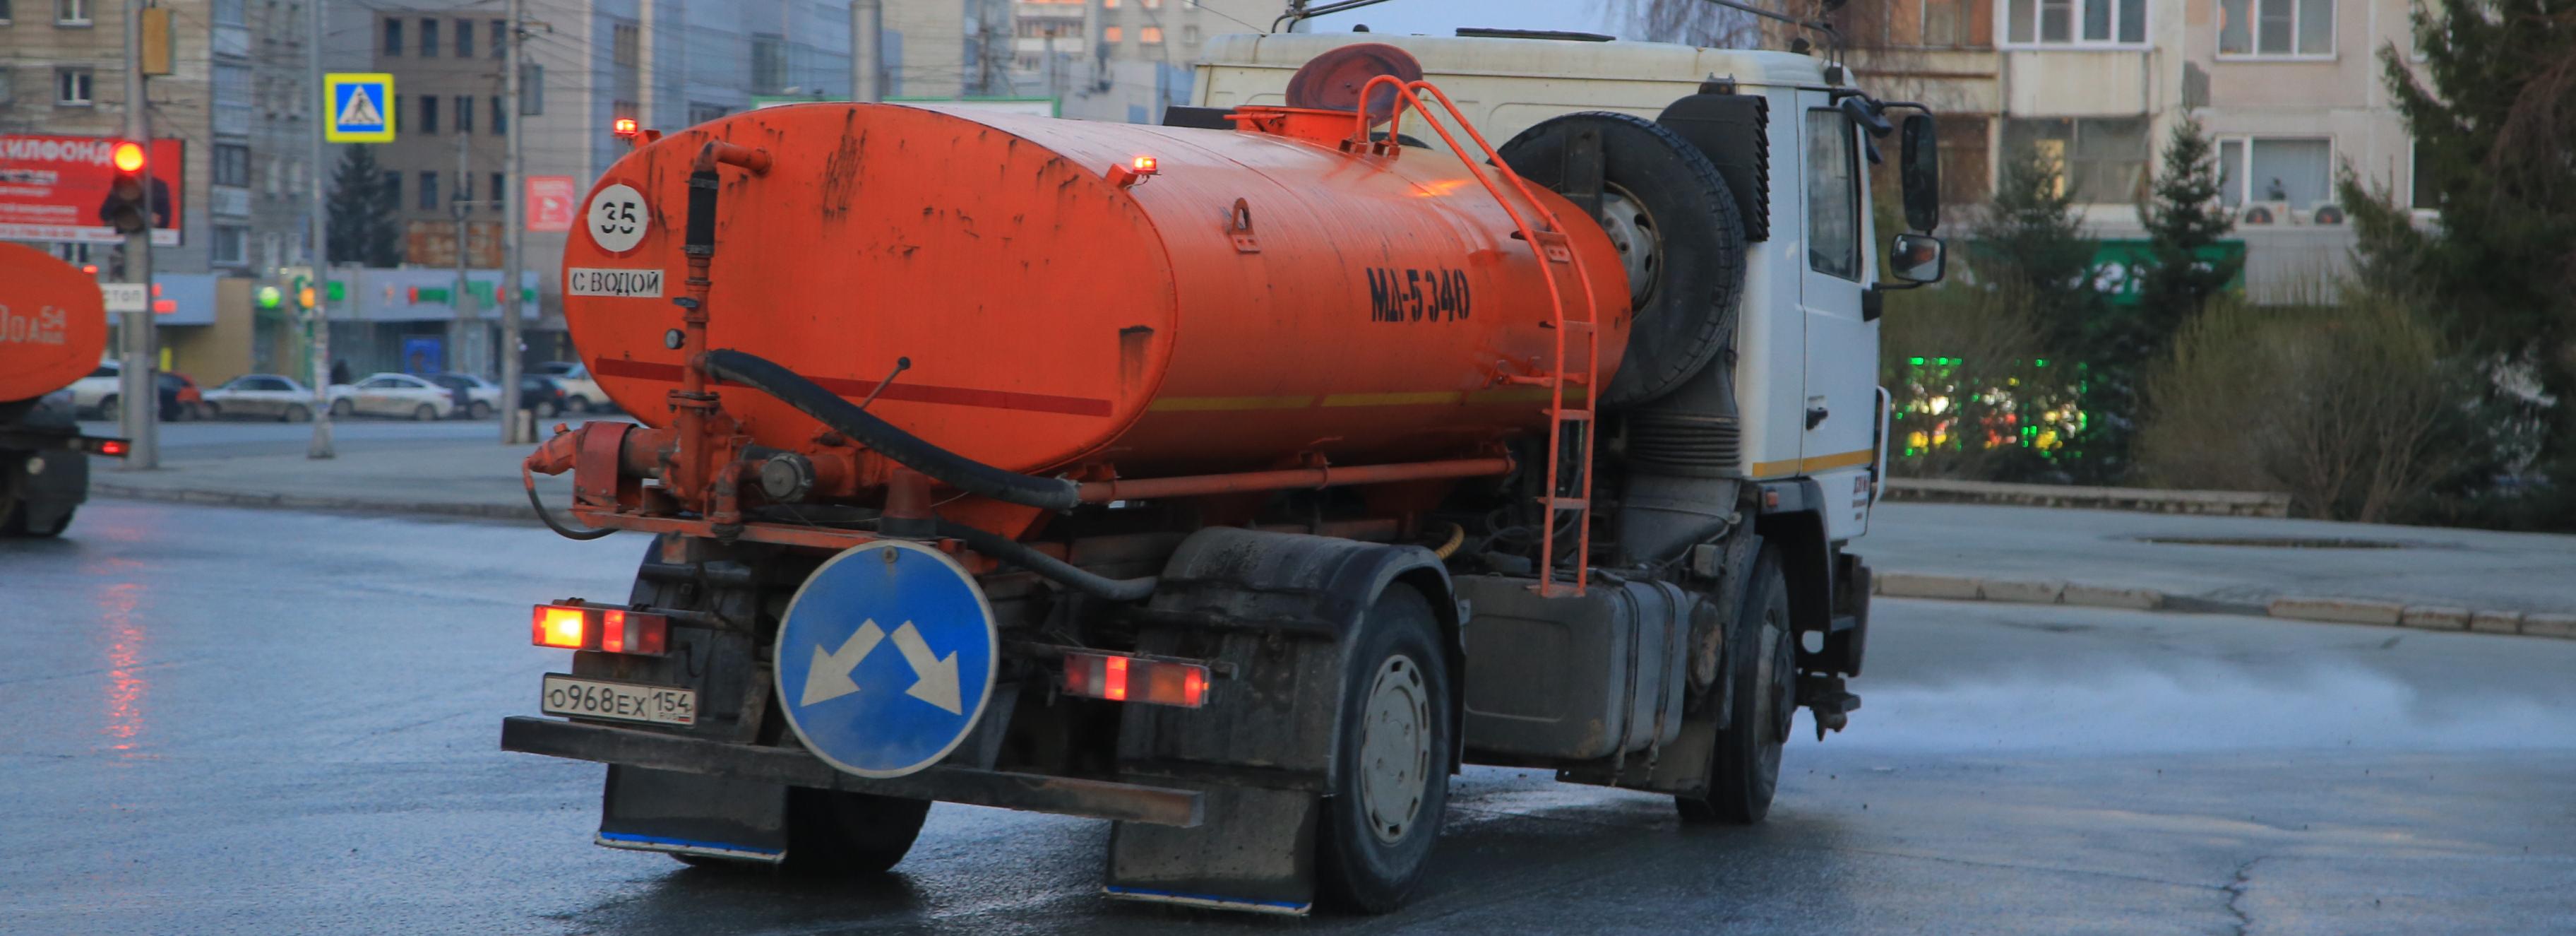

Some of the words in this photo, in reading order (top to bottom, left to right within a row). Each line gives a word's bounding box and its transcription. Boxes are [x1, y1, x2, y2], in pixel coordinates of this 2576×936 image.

[601, 202, 636, 234] 35
[573, 272, 585, 291] С
[590, 271, 659, 296] ВОДОЙ
[552, 685, 646, 716] О968ЕХ
[652, 692, 689, 713] 154
